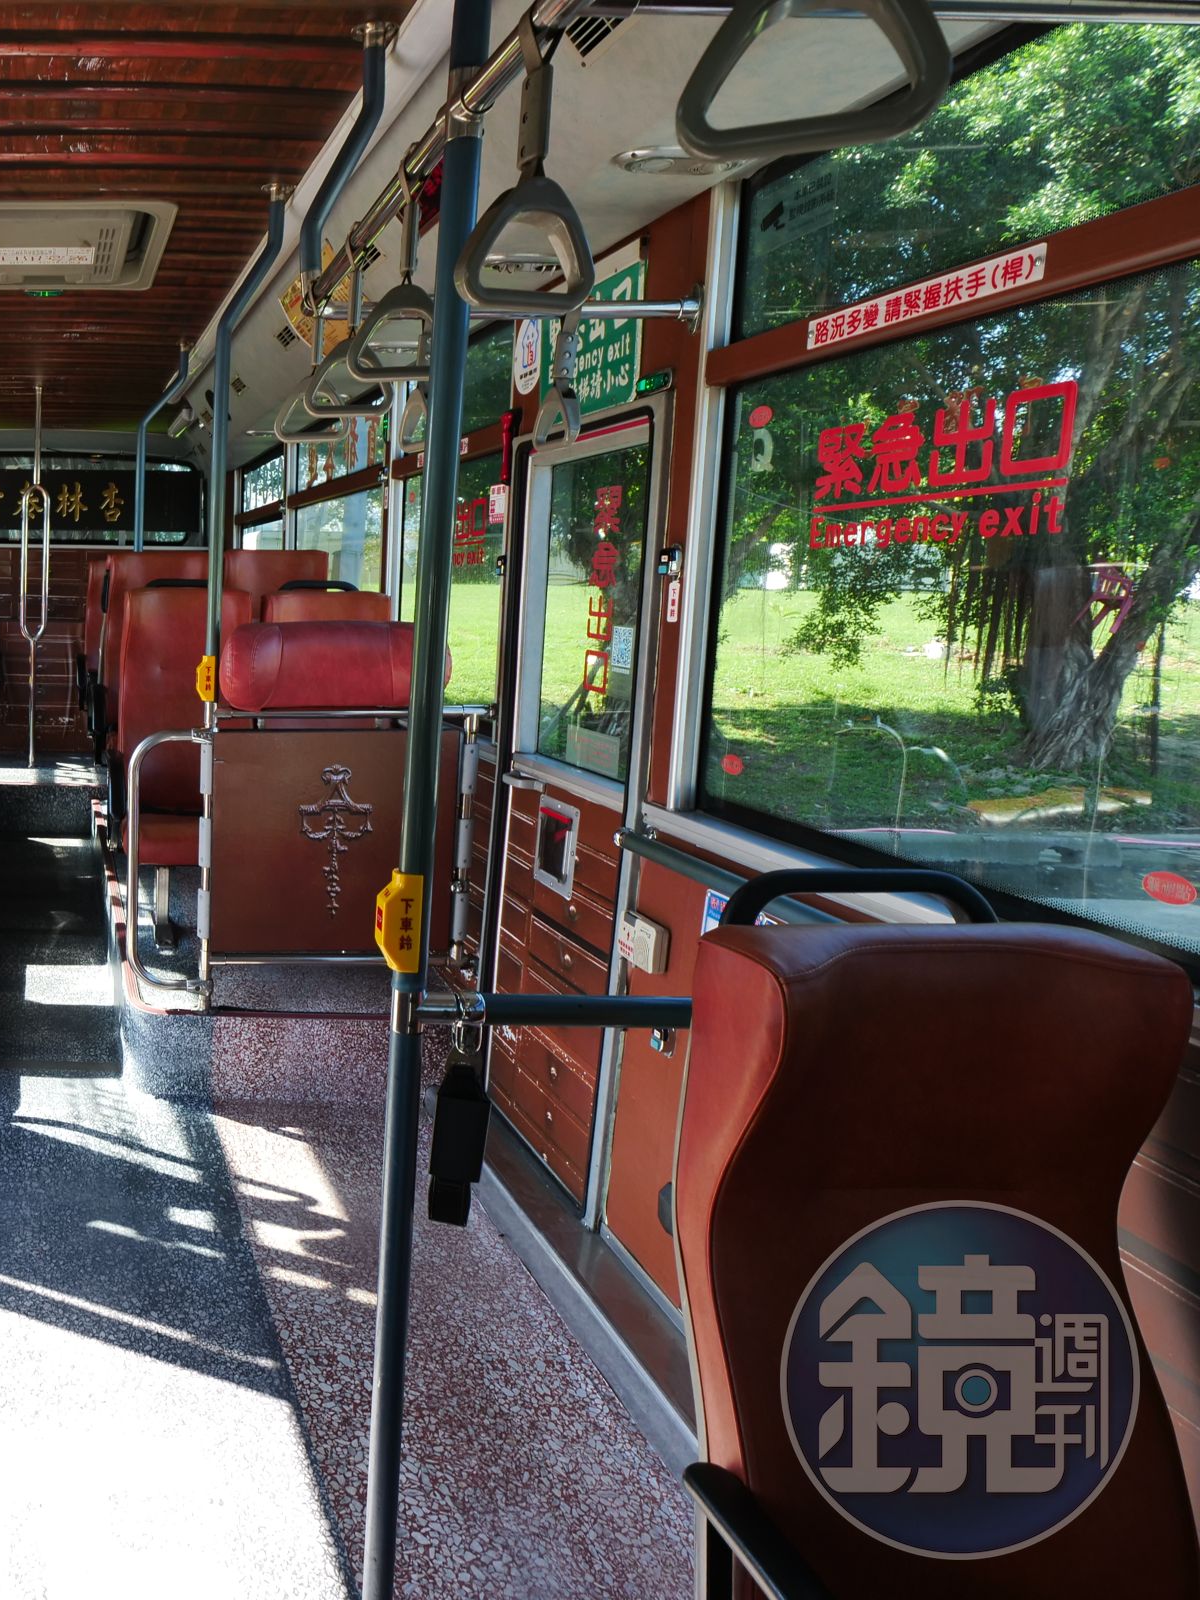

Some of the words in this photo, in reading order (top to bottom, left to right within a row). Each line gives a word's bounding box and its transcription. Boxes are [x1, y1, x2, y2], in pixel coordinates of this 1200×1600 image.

[814, 304, 879, 345] 路況多變
[884, 254, 1035, 322] 請緊握扶手(桿)
[607, 331, 630, 361] exit
[813, 380, 1078, 500] 緊急出口
[809, 510, 969, 549] Emergency
[978, 491, 1065, 539] exit
[399, 898, 415, 951] 下車鈴
